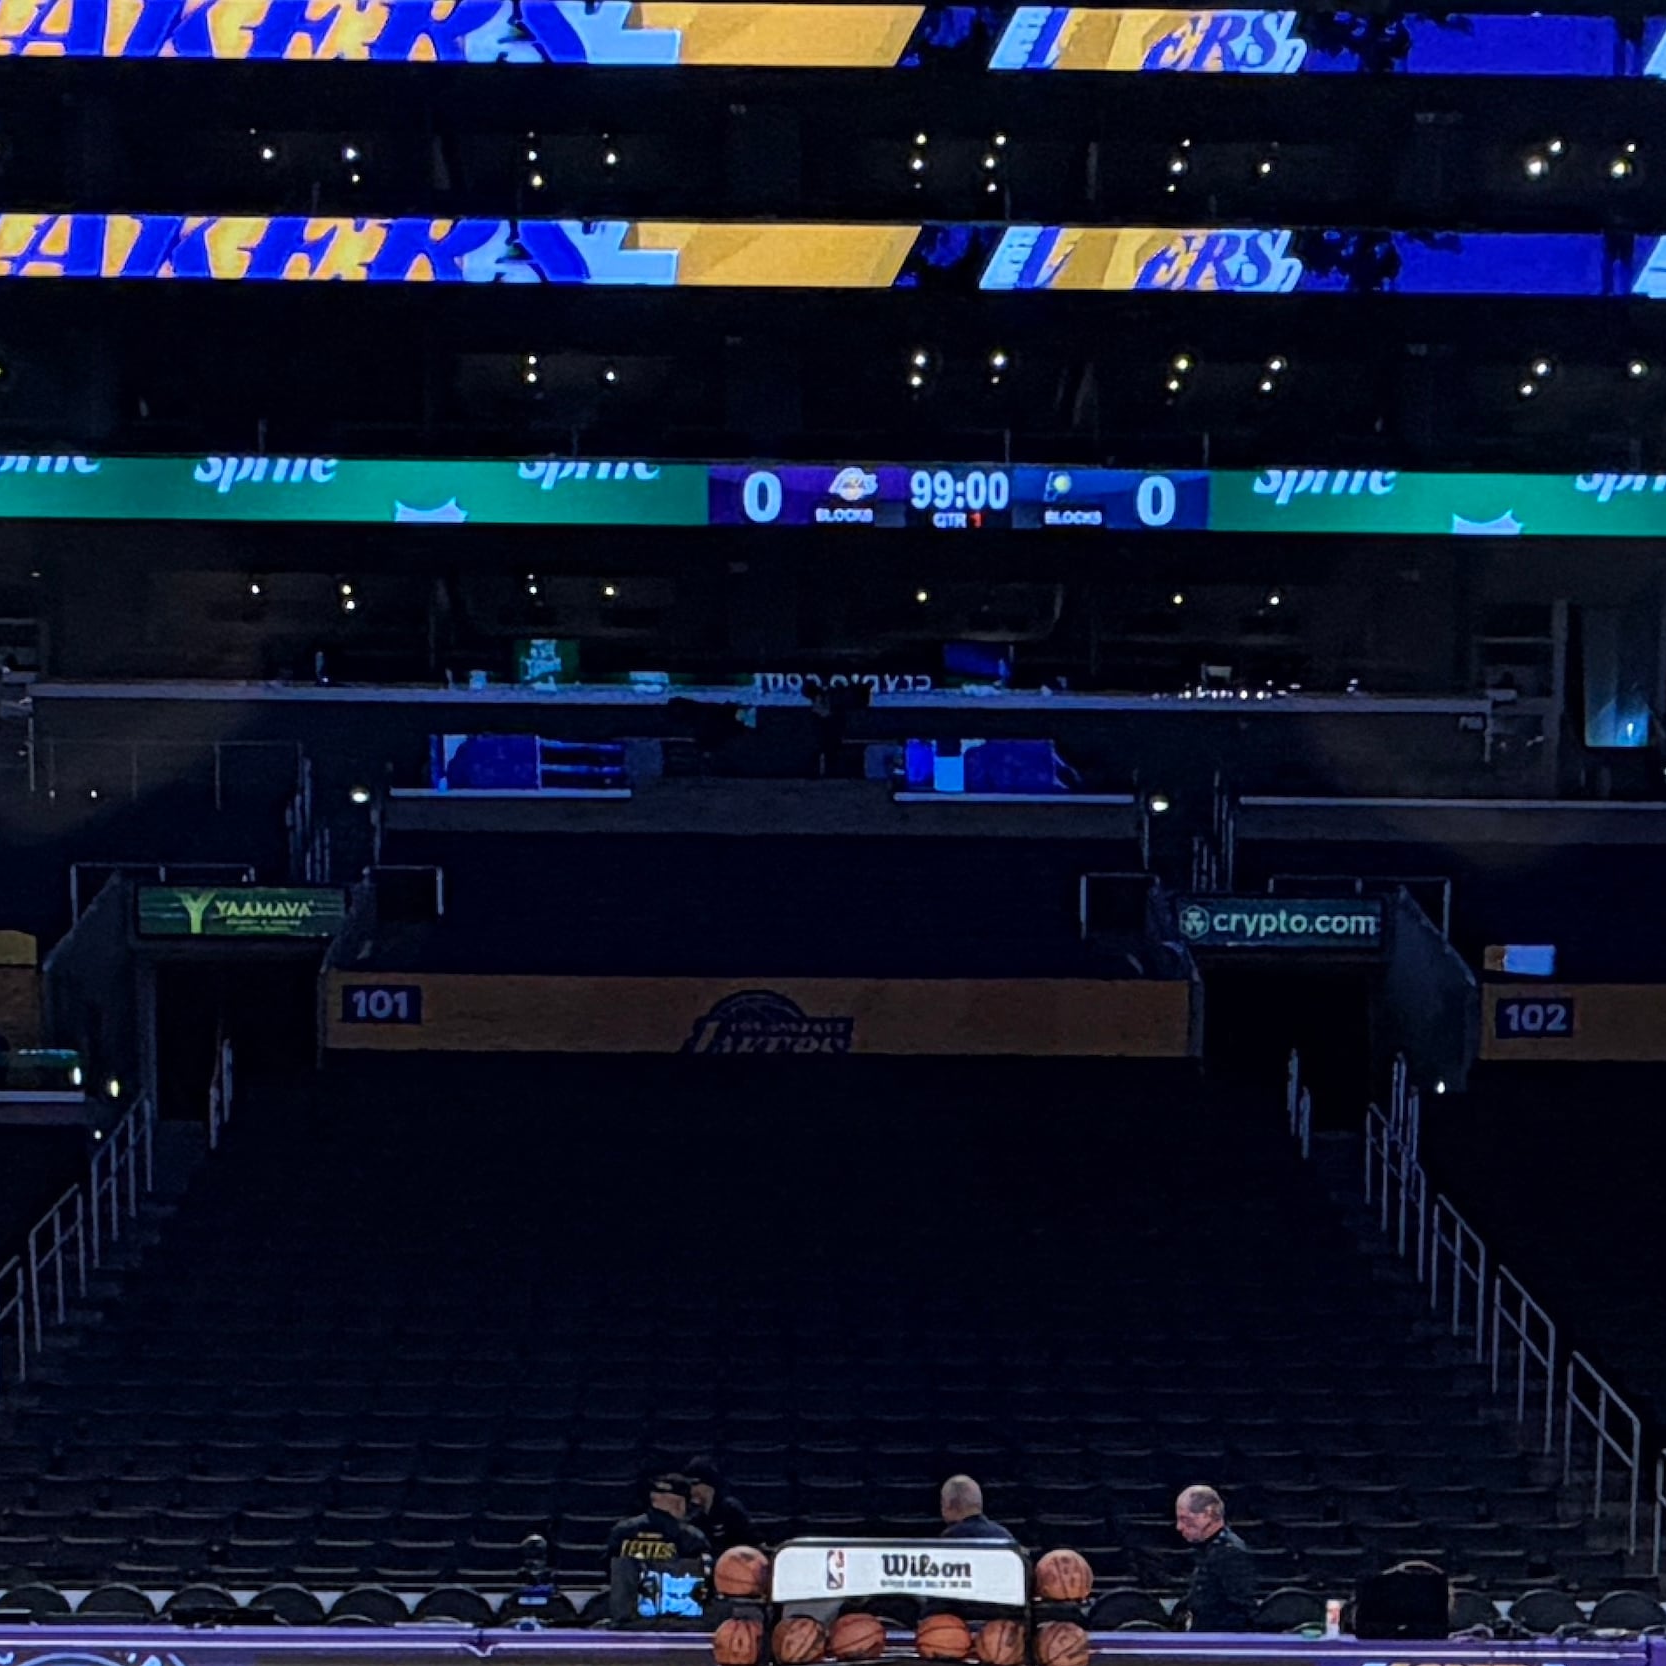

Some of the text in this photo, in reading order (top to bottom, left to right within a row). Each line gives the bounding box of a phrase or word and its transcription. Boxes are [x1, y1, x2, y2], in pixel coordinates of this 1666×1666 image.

[743, 472, 781, 522] 0
[910, 471, 1009, 510] 99:00
[1136, 475, 1175, 526] 0
[932, 513, 967, 528] QTR
[1043, 510, 1103, 525] BLOCKS
[1213, 909, 1379, 938] crypto.com
[352, 988, 410, 1020] 101
[1505, 1003, 1568, 1032] 102
[880, 1554, 973, 1578] Wilson
